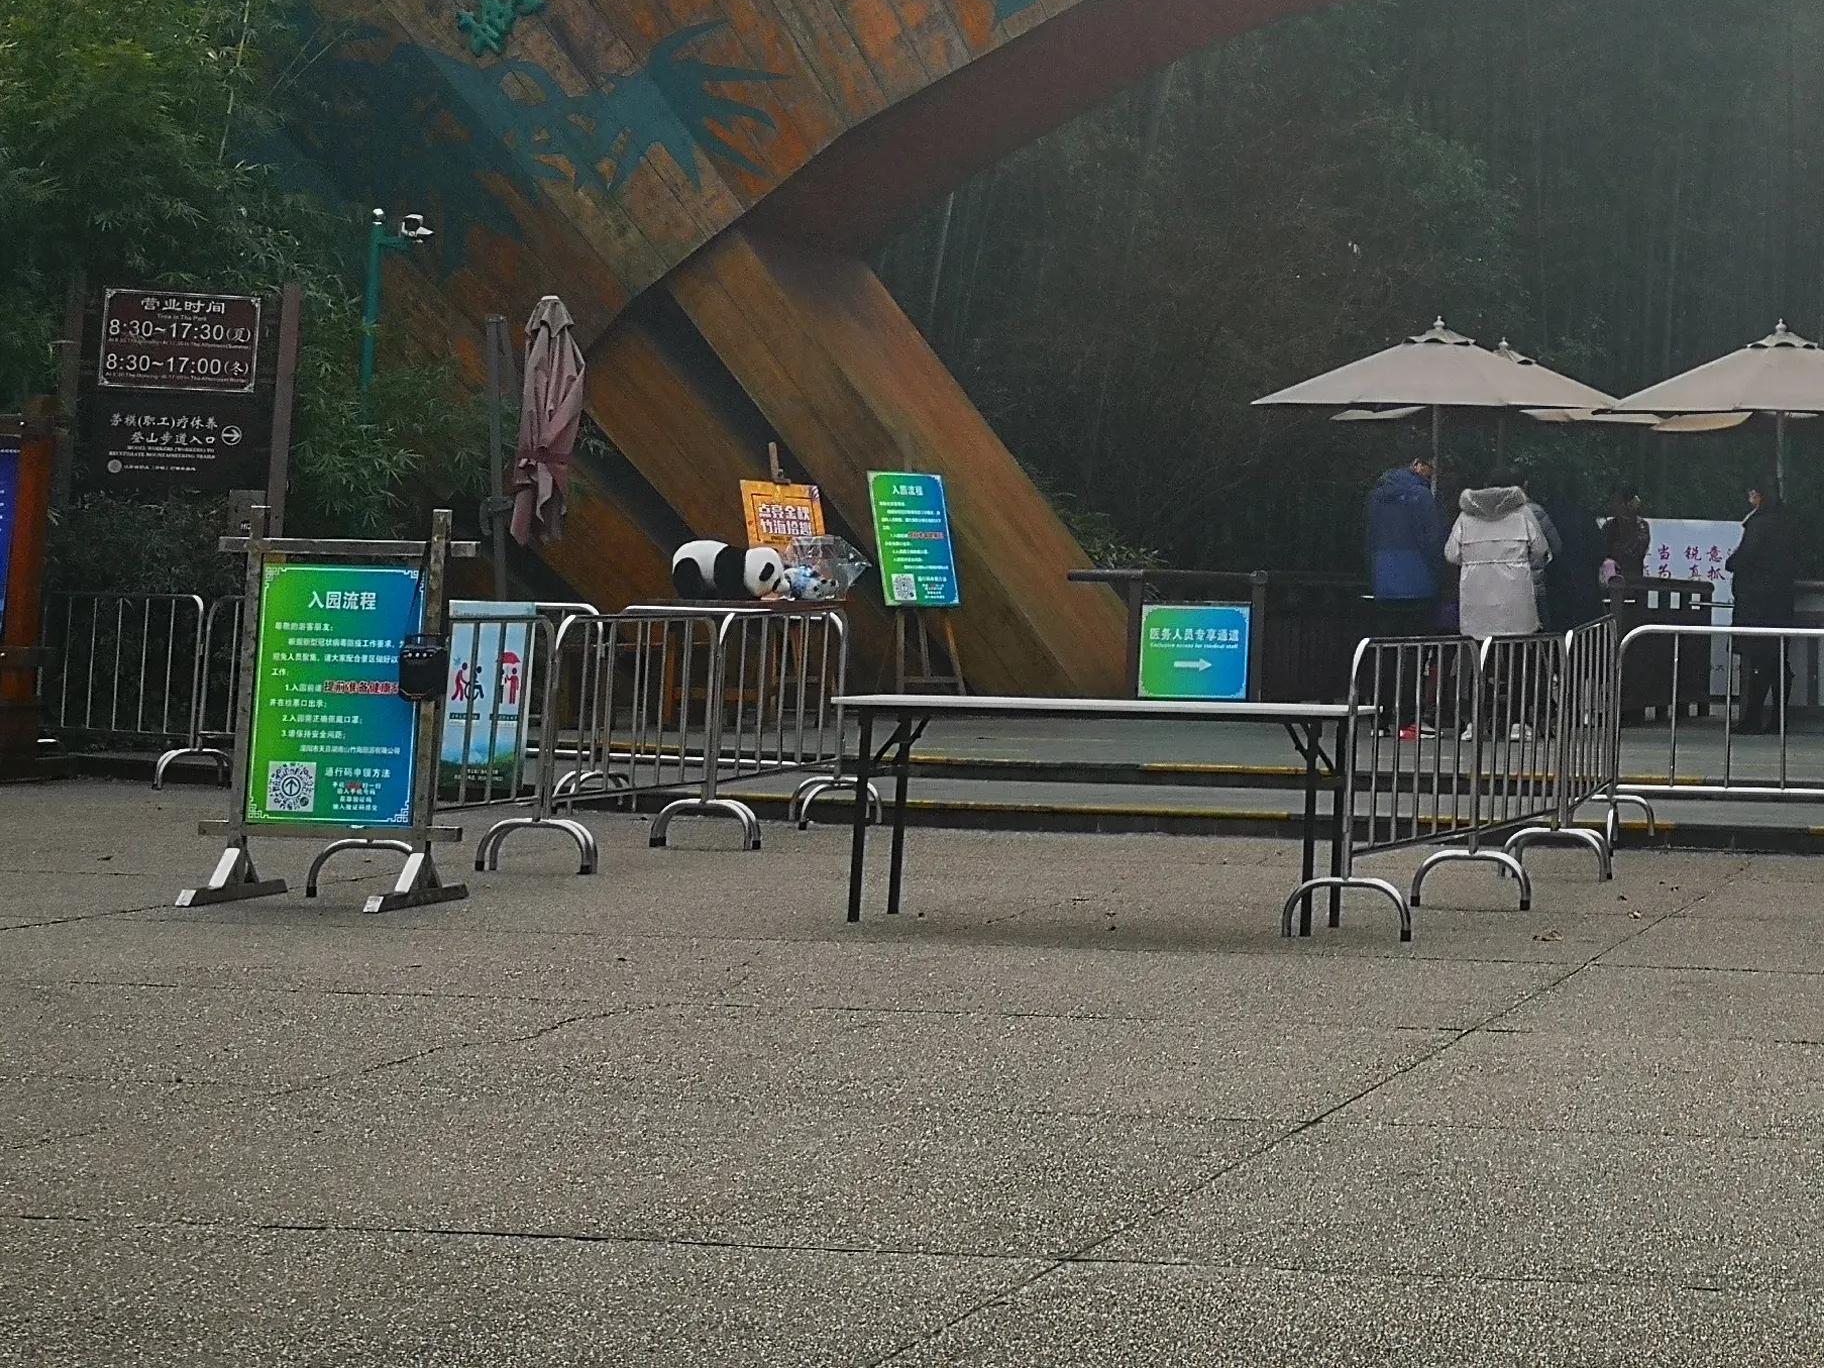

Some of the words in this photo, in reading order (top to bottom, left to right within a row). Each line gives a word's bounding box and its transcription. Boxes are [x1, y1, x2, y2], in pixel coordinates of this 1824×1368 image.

[141, 297, 225, 315] 营业时间
[109, 319, 251, 343] 8:30~17:30(夏)
[106, 353, 249, 376] 8:30~17:00(冬)
[110, 412, 218, 430] 劳模(职工)疗休养
[131, 431, 216, 446] 登山步道入口
[308, 591, 377, 611] 入园流程
[1149, 628, 1240, 642] 医务人员专享通道
